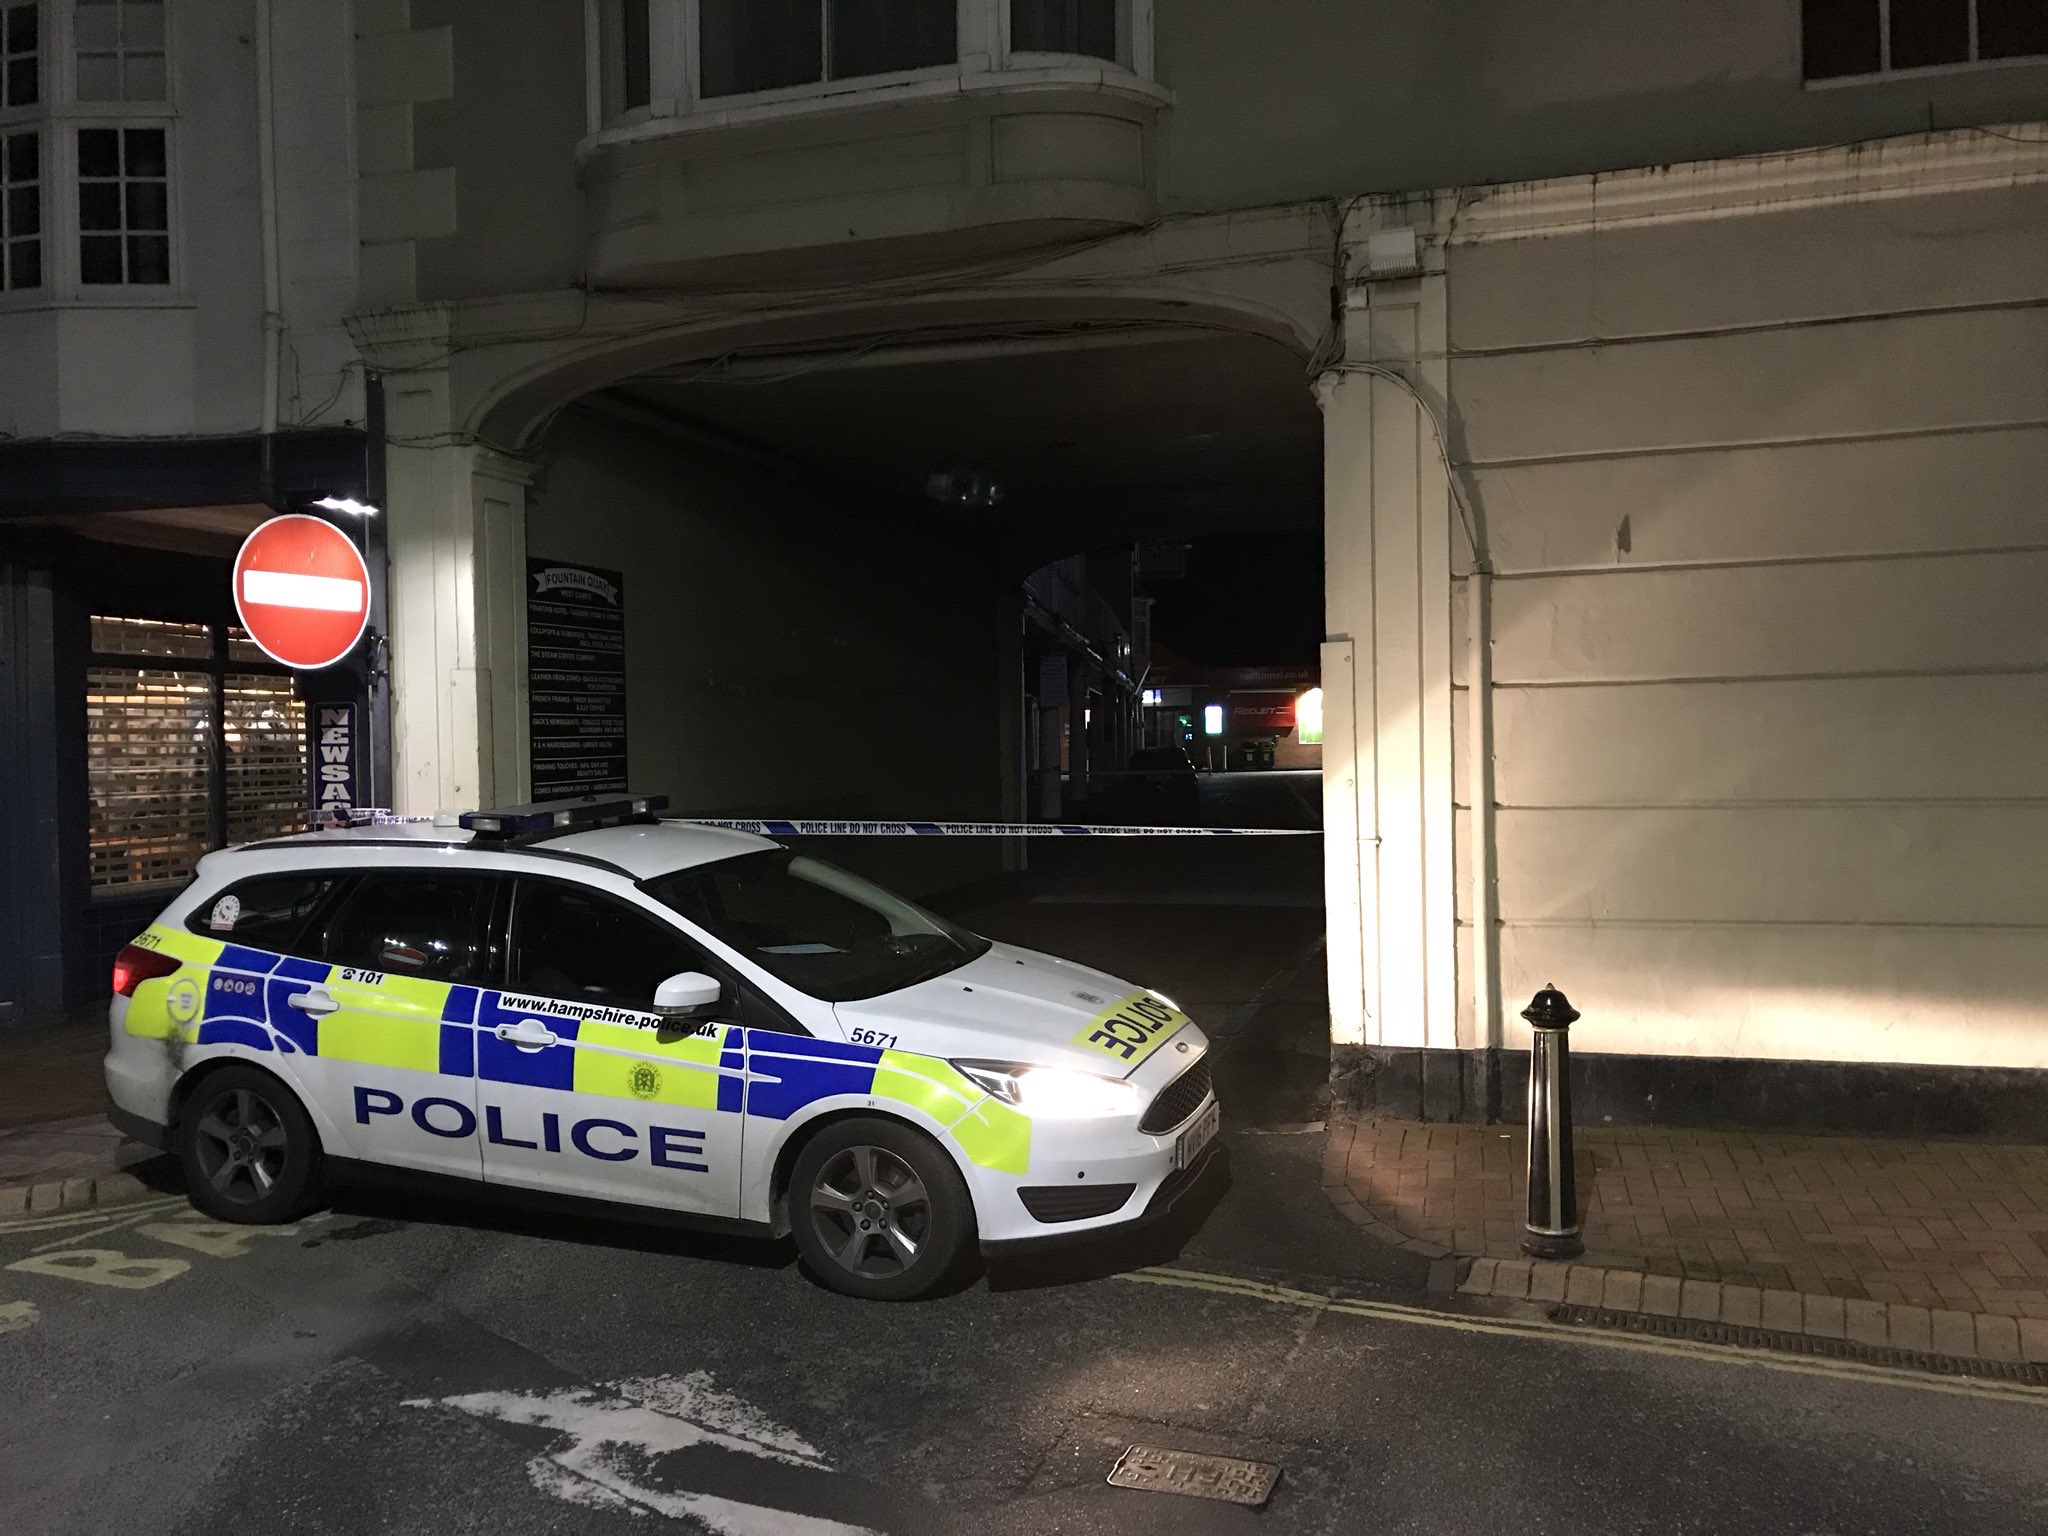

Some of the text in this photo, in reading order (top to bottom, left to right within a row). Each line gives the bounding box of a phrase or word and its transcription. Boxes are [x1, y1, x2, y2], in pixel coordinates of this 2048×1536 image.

[546, 573, 609, 593] FOUNTAIN QUAY
[735, 821, 761, 833] CROSS
[800, 822, 906, 834] POLICE LINE DO NOT CROSS
[946, 823, 974, 834] POLICE
[976, 825, 993, 834] LINE
[995, 825, 1006, 834] DO
[1009, 825, 1024, 834] NOT
[358, 971, 384, 985] 101
[502, 996, 718, 1039] www.hampshire.police.uk
[850, 1027, 898, 1049] 5671
[353, 1085, 710, 1173] POLICE
